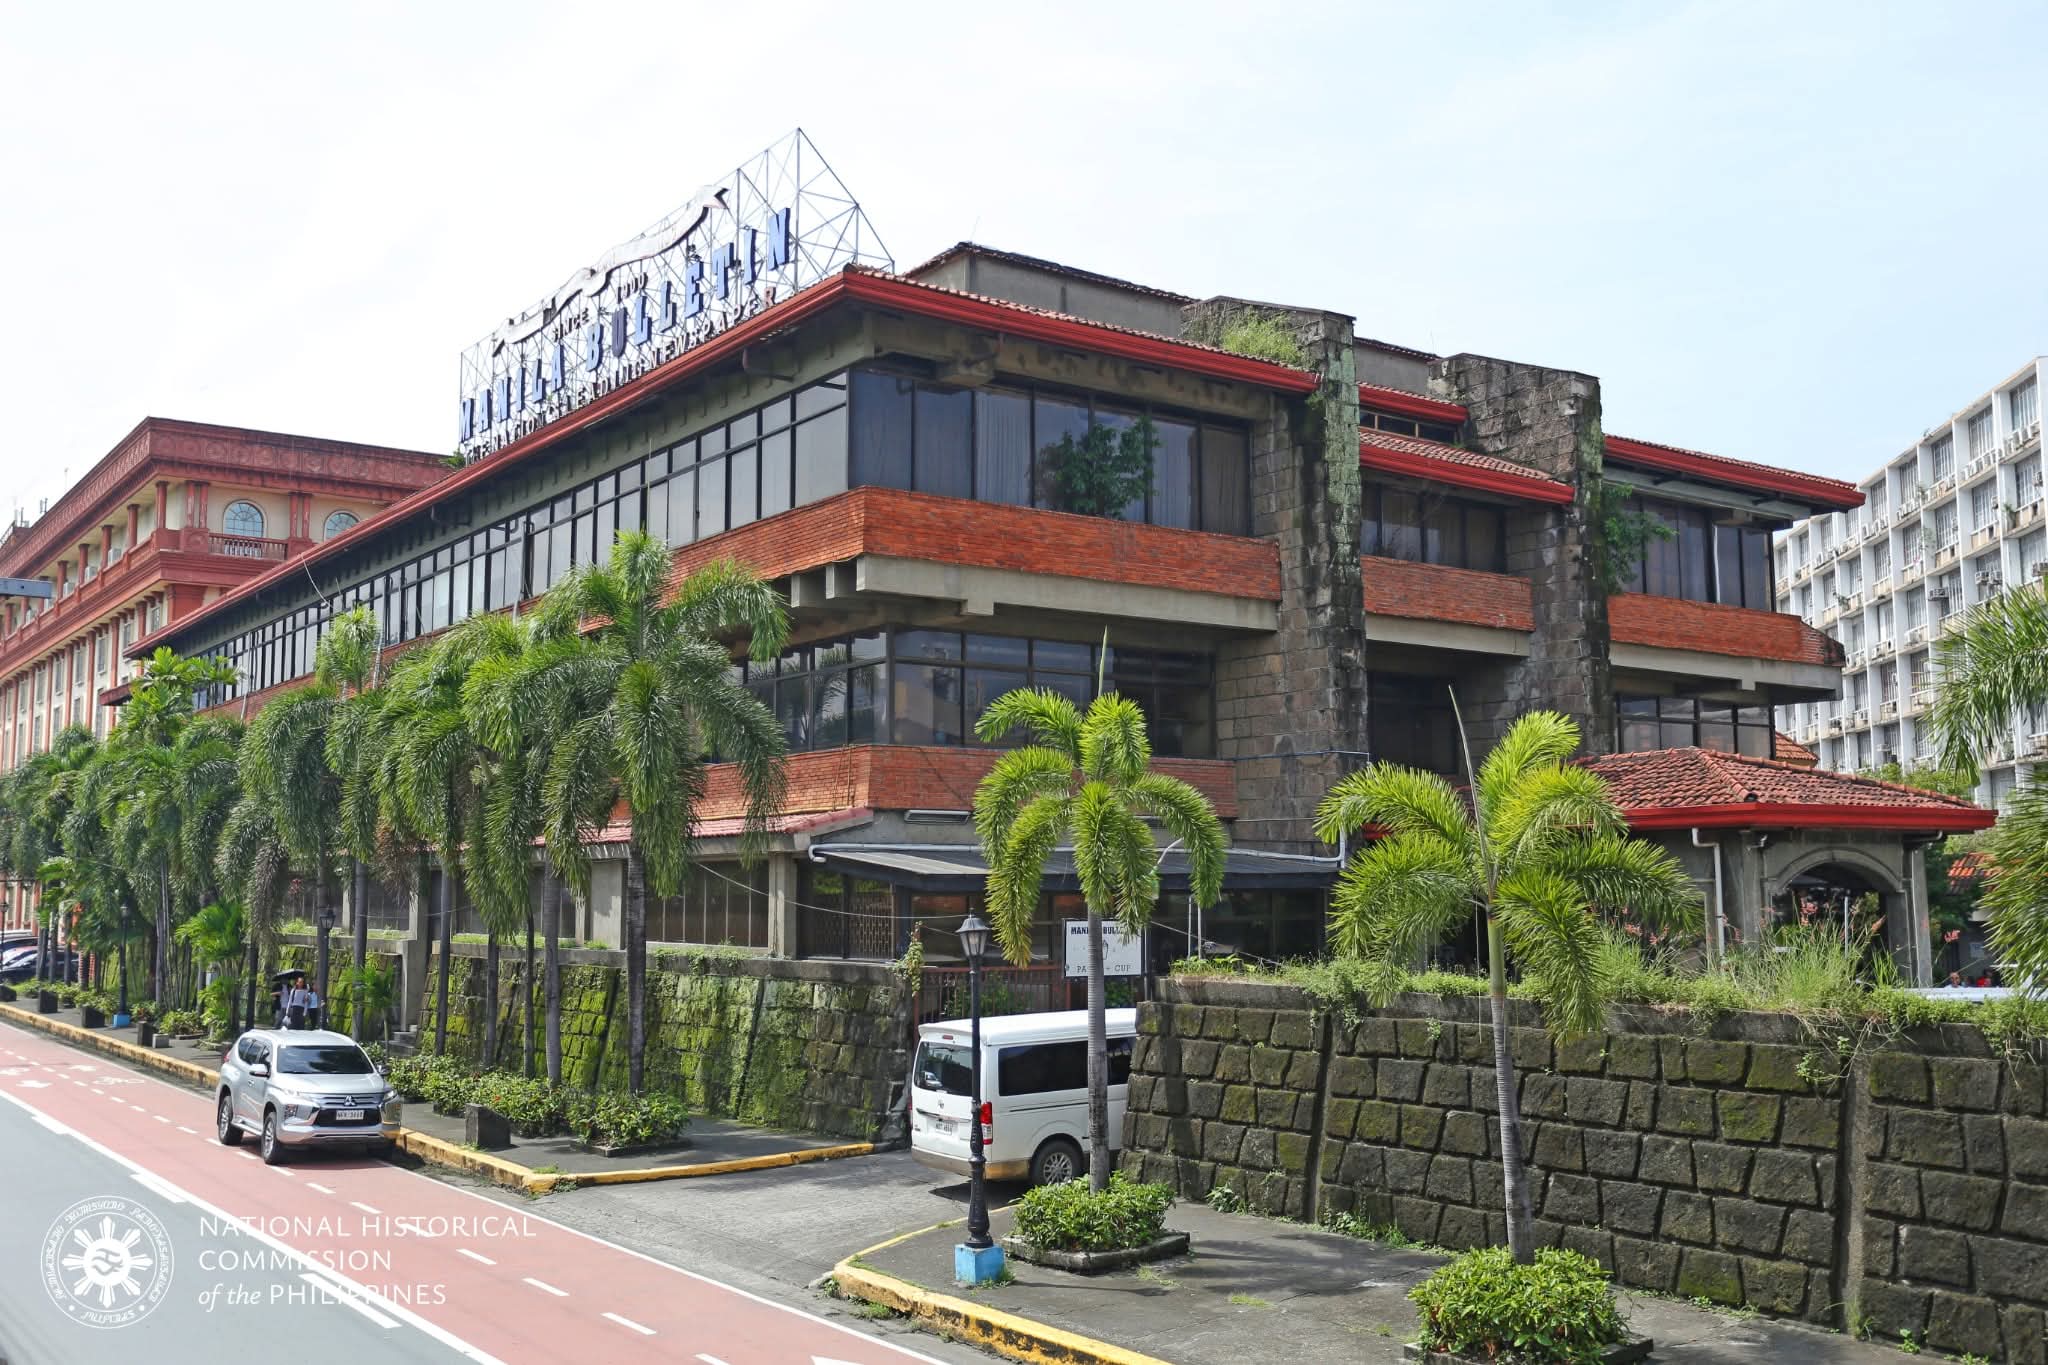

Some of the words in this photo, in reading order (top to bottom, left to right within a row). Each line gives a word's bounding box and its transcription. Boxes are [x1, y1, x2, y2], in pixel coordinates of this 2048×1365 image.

[459, 342, 565, 443] MANILA
[586, 207, 790, 372] BULLETIN
[650, 286, 776, 369] NEWSPAPER
